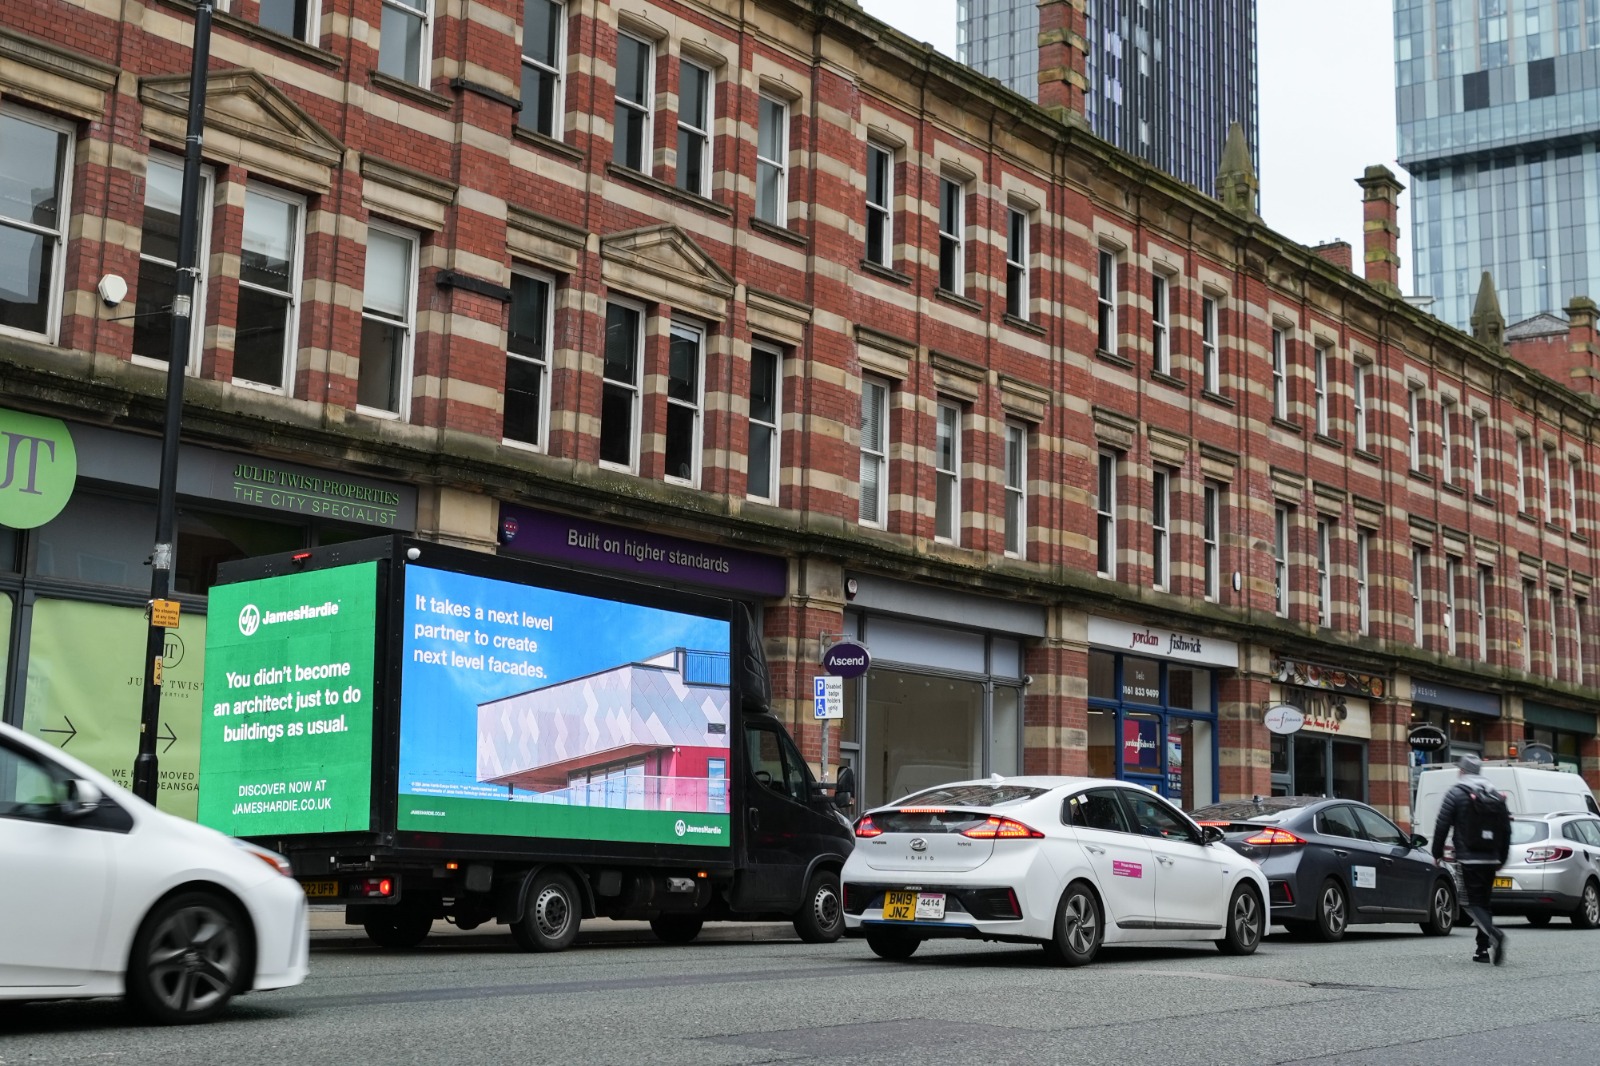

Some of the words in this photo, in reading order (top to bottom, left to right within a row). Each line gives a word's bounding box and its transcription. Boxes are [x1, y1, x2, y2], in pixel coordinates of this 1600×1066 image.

[0, 431, 55, 495] JT
[234, 464, 276, 484] JULIE
[278, 472, 320, 492] TWIST
[322, 480, 399, 506] PROPERTIES
[234, 486, 263, 502] THE
[271, 494, 306, 510] CITY
[312, 500, 396, 524] SPECIALIST
[568, 529, 599, 549] Built
[604, 539, 620, 554] on
[625, 539, 665, 562] higher
[669, 549, 729, 573] standards
[262, 602, 338, 624] JamesHardie
[416, 594, 426, 611] It
[430, 598, 470, 618] takes
[475, 608, 483, 620] a
[488, 610, 518, 625] next
[523, 612, 552, 631] level
[415, 624, 470, 642] partner
[474, 630, 488, 645] to
[493, 635, 537, 652] create
[1167, 634, 1201, 654] fishwick
[414, 649, 447, 665] next
[452, 651, 484, 670] level
[488, 656, 547, 679] facades.
[829, 656, 864, 665] Ascend
[226, 672, 250, 688] You
[254, 666, 292, 685] didn't
[295, 662, 350, 681] become
[214, 702, 229, 716] an
[234, 693, 292, 714] architect
[295, 690, 321, 712] just
[325, 689, 338, 704] to
[343, 686, 361, 703] do
[1135, 687, 1145, 696] 833
[1146, 689, 1159, 698] 9499
[1418, 687, 1437, 697] RESIDE
[224, 723, 283, 742] buildings
[288, 722, 303, 736] as
[308, 715, 348, 734] usual.
[160, 772, 194, 780] MOVED
[239, 783, 285, 796] DISCOVER
[289, 781, 312, 793] NOW
[315, 780, 326, 791] AT
[232, 798, 332, 814] JAMESHARDIE.CO.UK
[318, 883, 334, 894] UFR
[890, 893, 912, 905] BM19
[889, 907, 909, 918] JNZ
